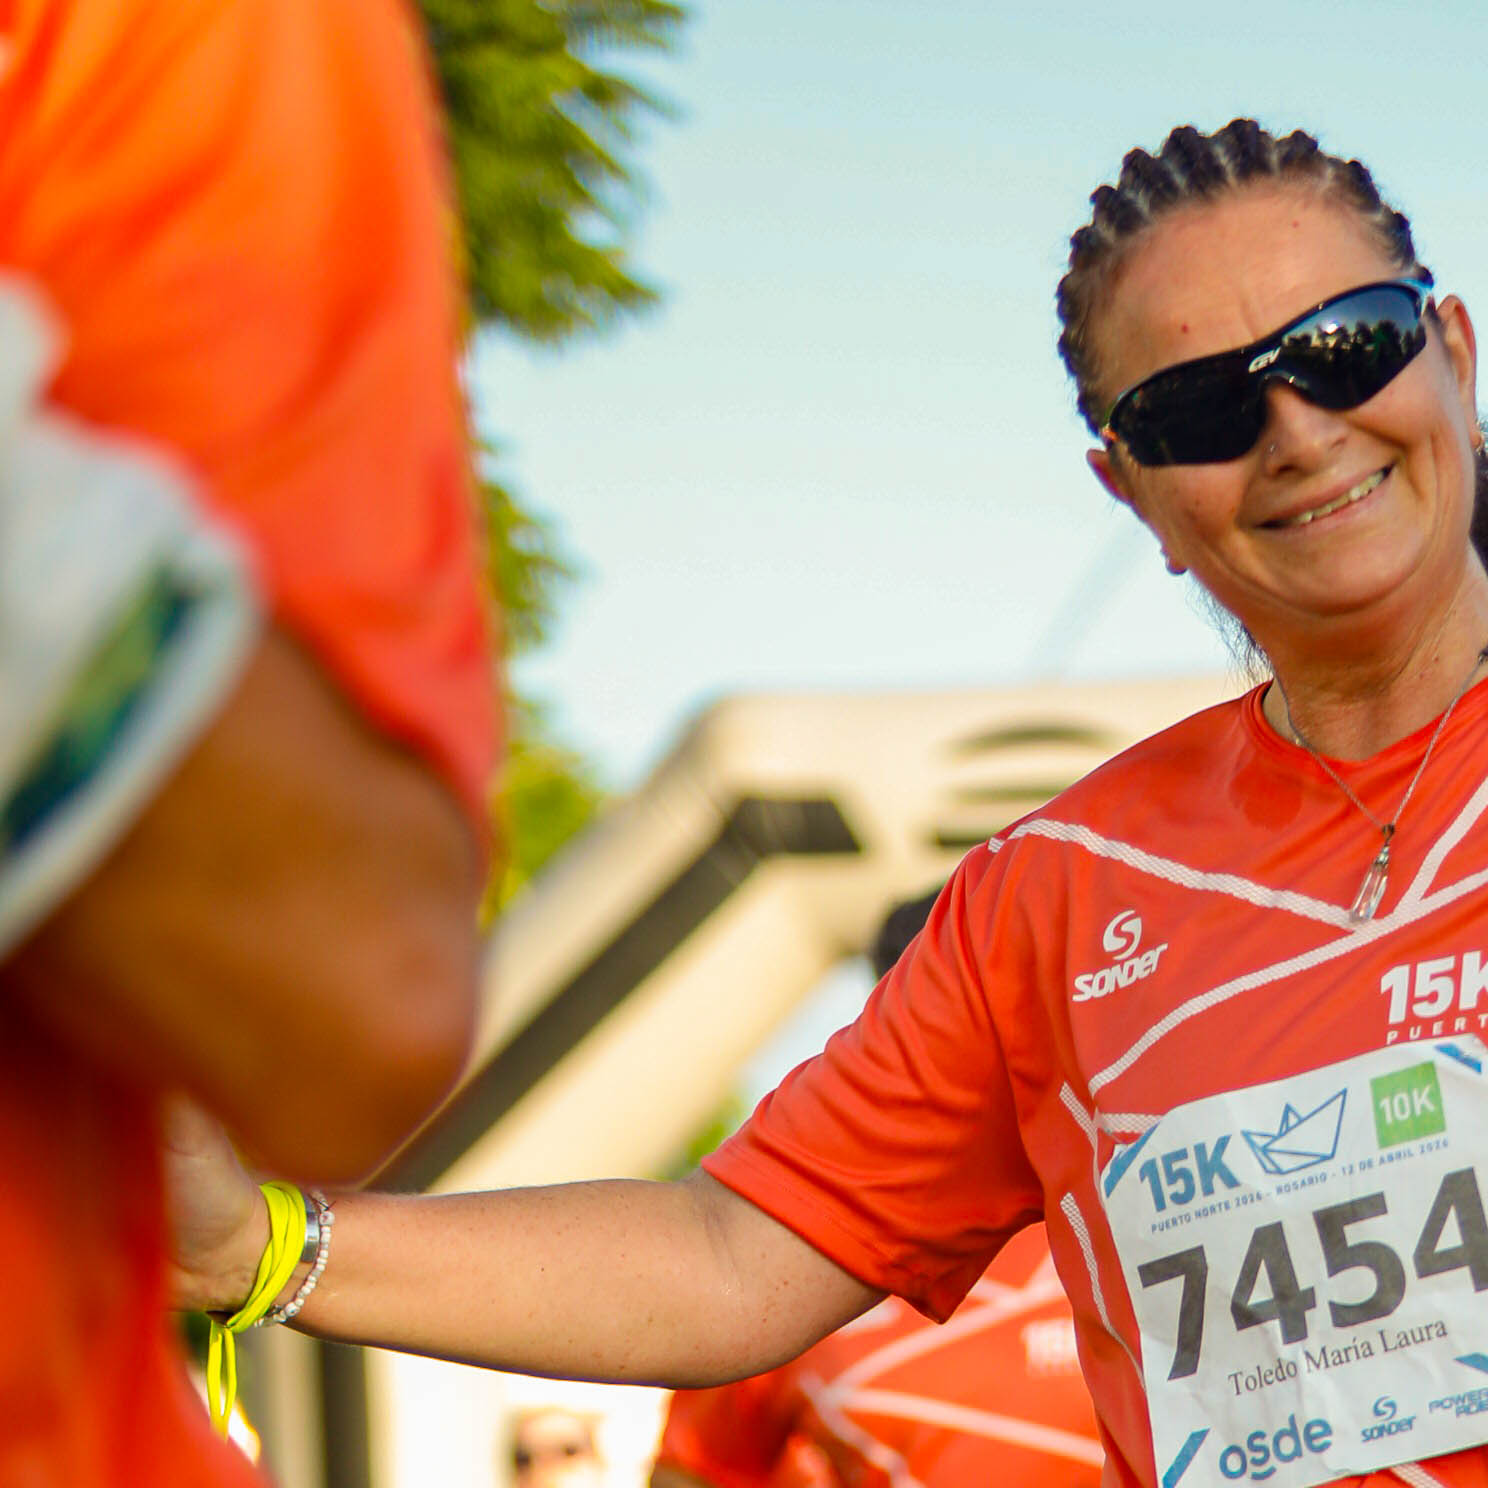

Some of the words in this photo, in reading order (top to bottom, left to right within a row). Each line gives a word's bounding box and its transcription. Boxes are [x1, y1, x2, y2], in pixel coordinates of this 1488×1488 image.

[1380, 1085, 1436, 1124] 10K
[1138, 1133, 1242, 1213] 15K
[1151, 1212, 1192, 1233] PUERTO
[1194, 1200, 1231, 1219] NORTE
[1275, 1172, 1328, 1195] ROSARIO
[1359, 1157, 1374, 1172] DE
[1379, 1148, 1415, 1165] ABRIL
[1227, 1359, 1298, 1396] Toledo
[1303, 1336, 1375, 1373] María
[1378, 1319, 1449, 1353] Laura
[1219, 1413, 1333, 1480] osde
